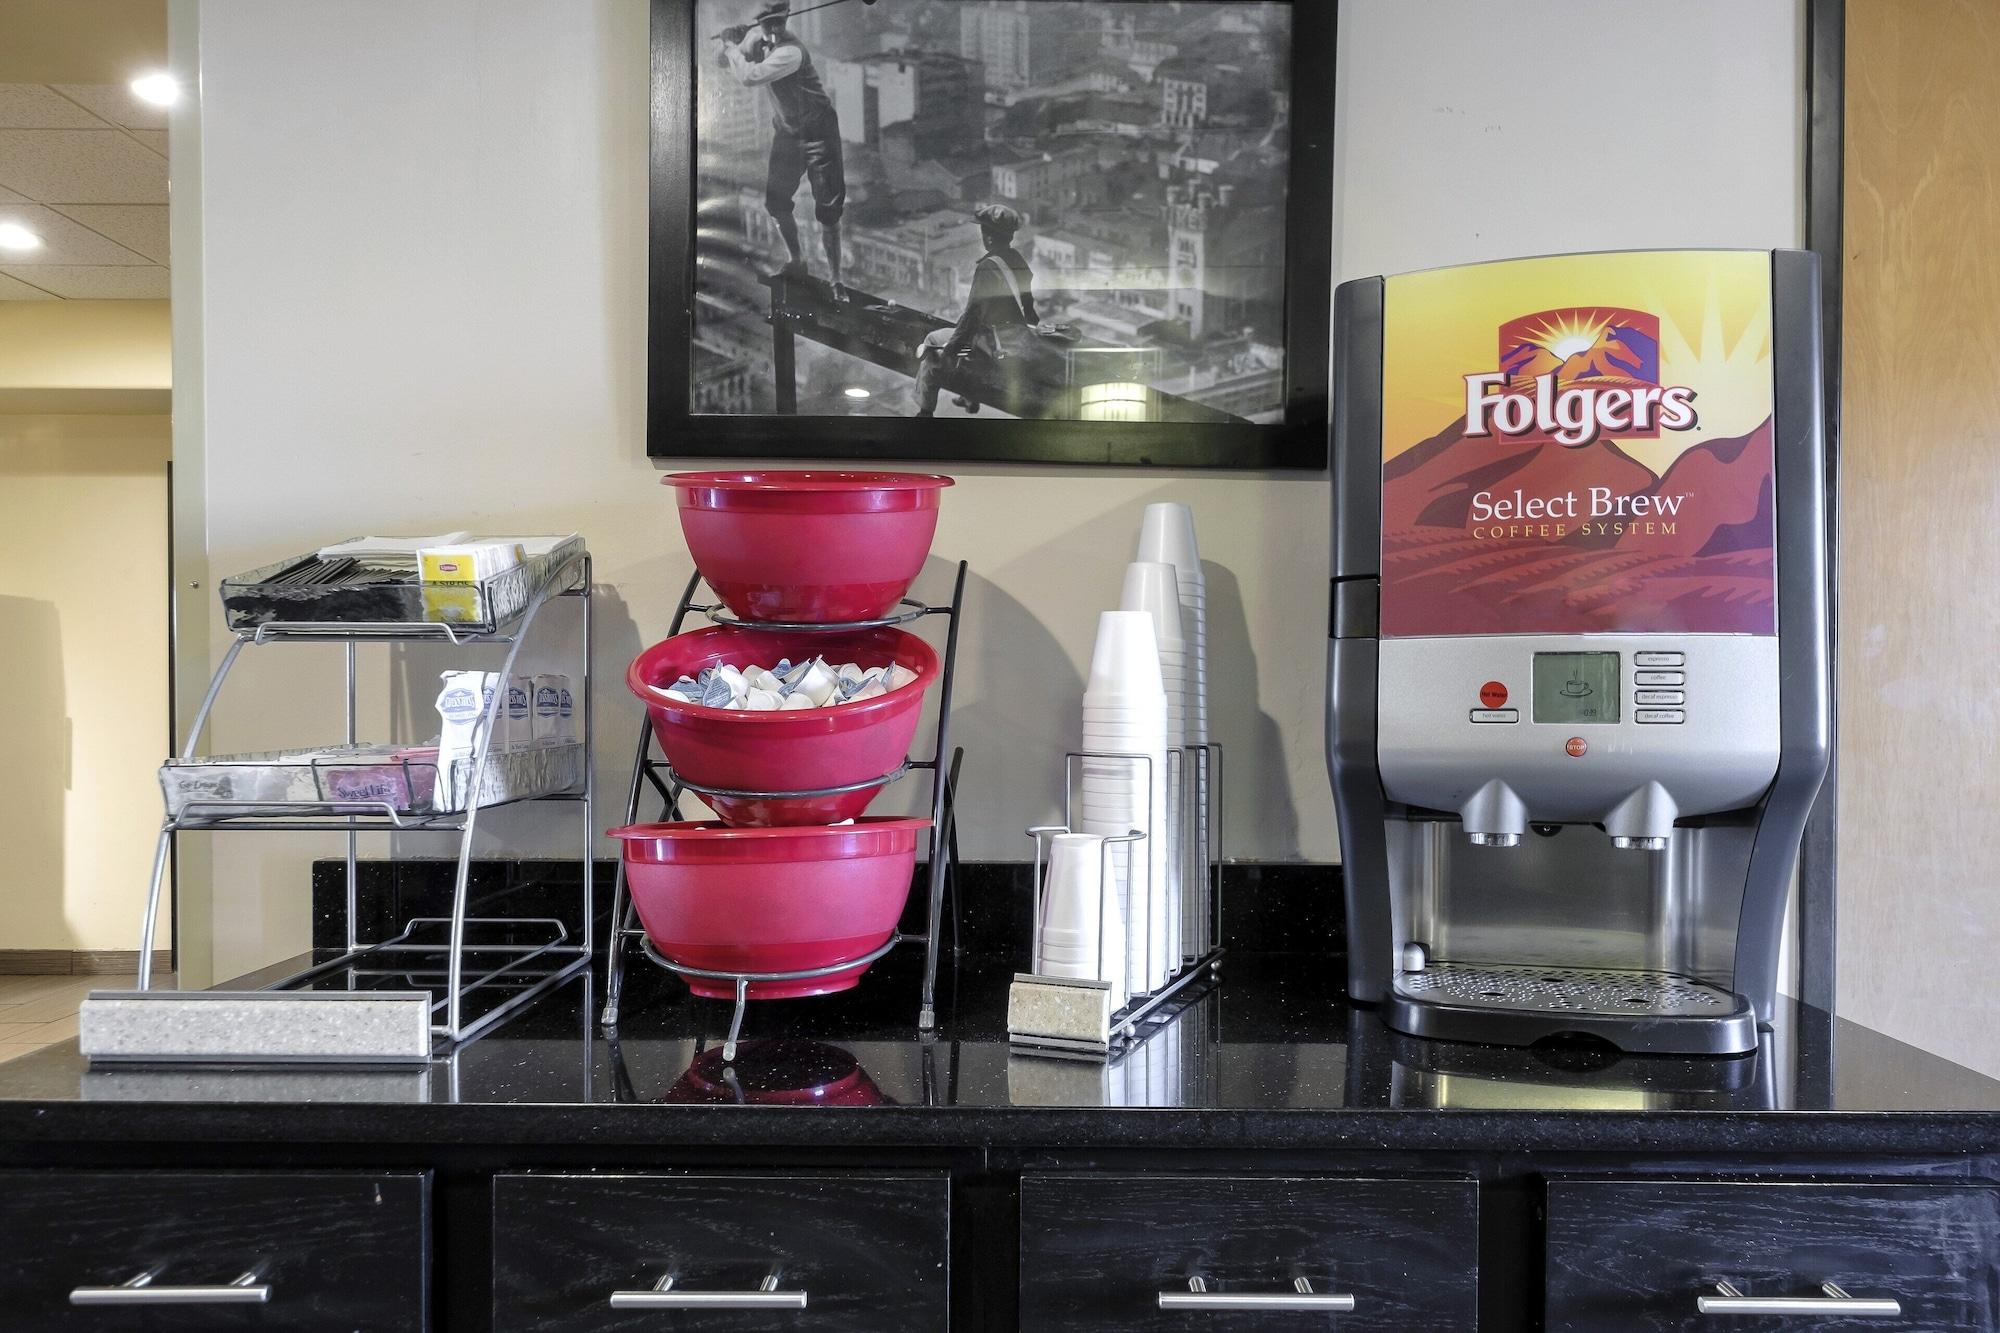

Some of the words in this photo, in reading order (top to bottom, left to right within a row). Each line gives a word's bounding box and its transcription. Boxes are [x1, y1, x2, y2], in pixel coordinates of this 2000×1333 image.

[1463, 372, 1698, 447] Folgers
[1472, 489, 1577, 521] Select
[1473, 524, 1566, 540] COFFEE
[1582, 522, 1676, 536] SYSTEM
